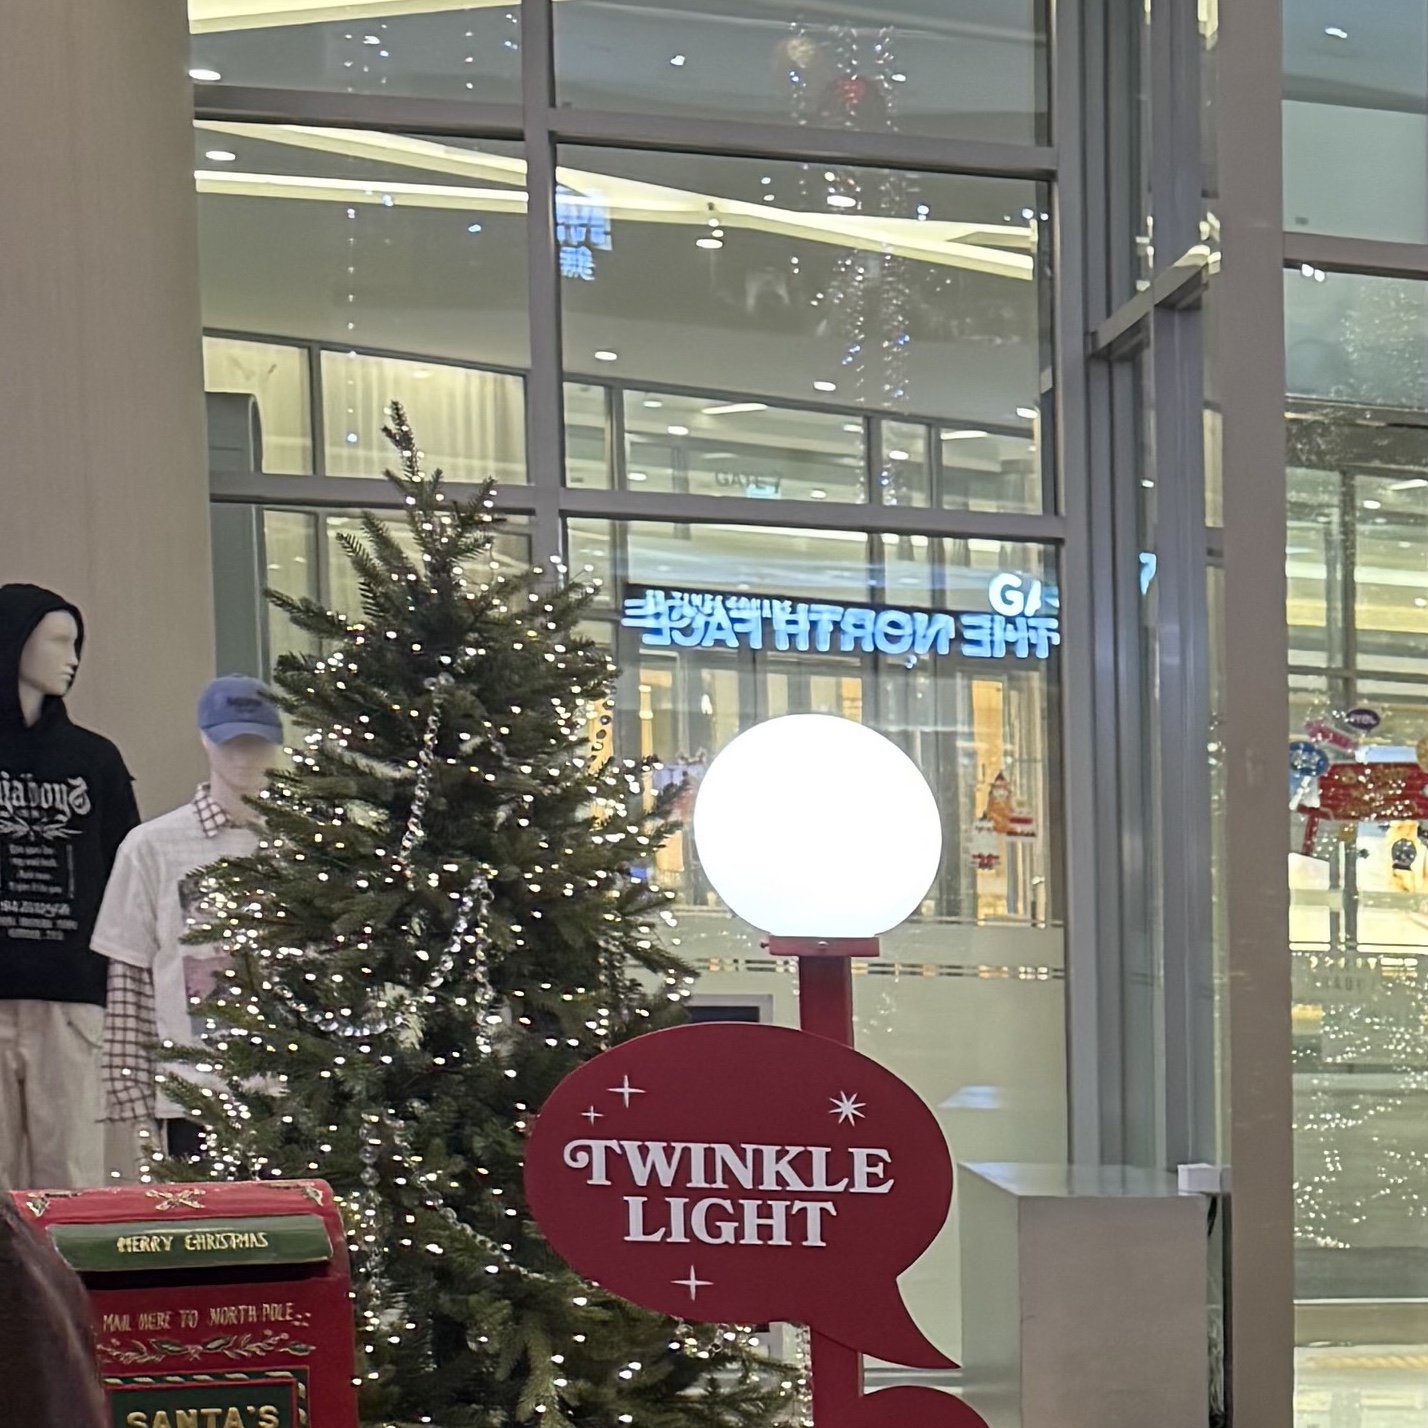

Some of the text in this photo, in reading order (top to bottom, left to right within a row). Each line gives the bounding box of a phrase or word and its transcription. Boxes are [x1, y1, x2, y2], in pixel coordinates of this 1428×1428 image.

[563, 1138, 895, 1195] TWINKLE
[623, 1196, 837, 1247] LIGHT
[117, 1230, 269, 1254] MERRY CHRISTMAS
[103, 1314, 131, 1332] MAIL
[138, 1312, 171, 1330] HERE
[179, 1309, 198, 1329] TO
[209, 1304, 257, 1326] NORTH
